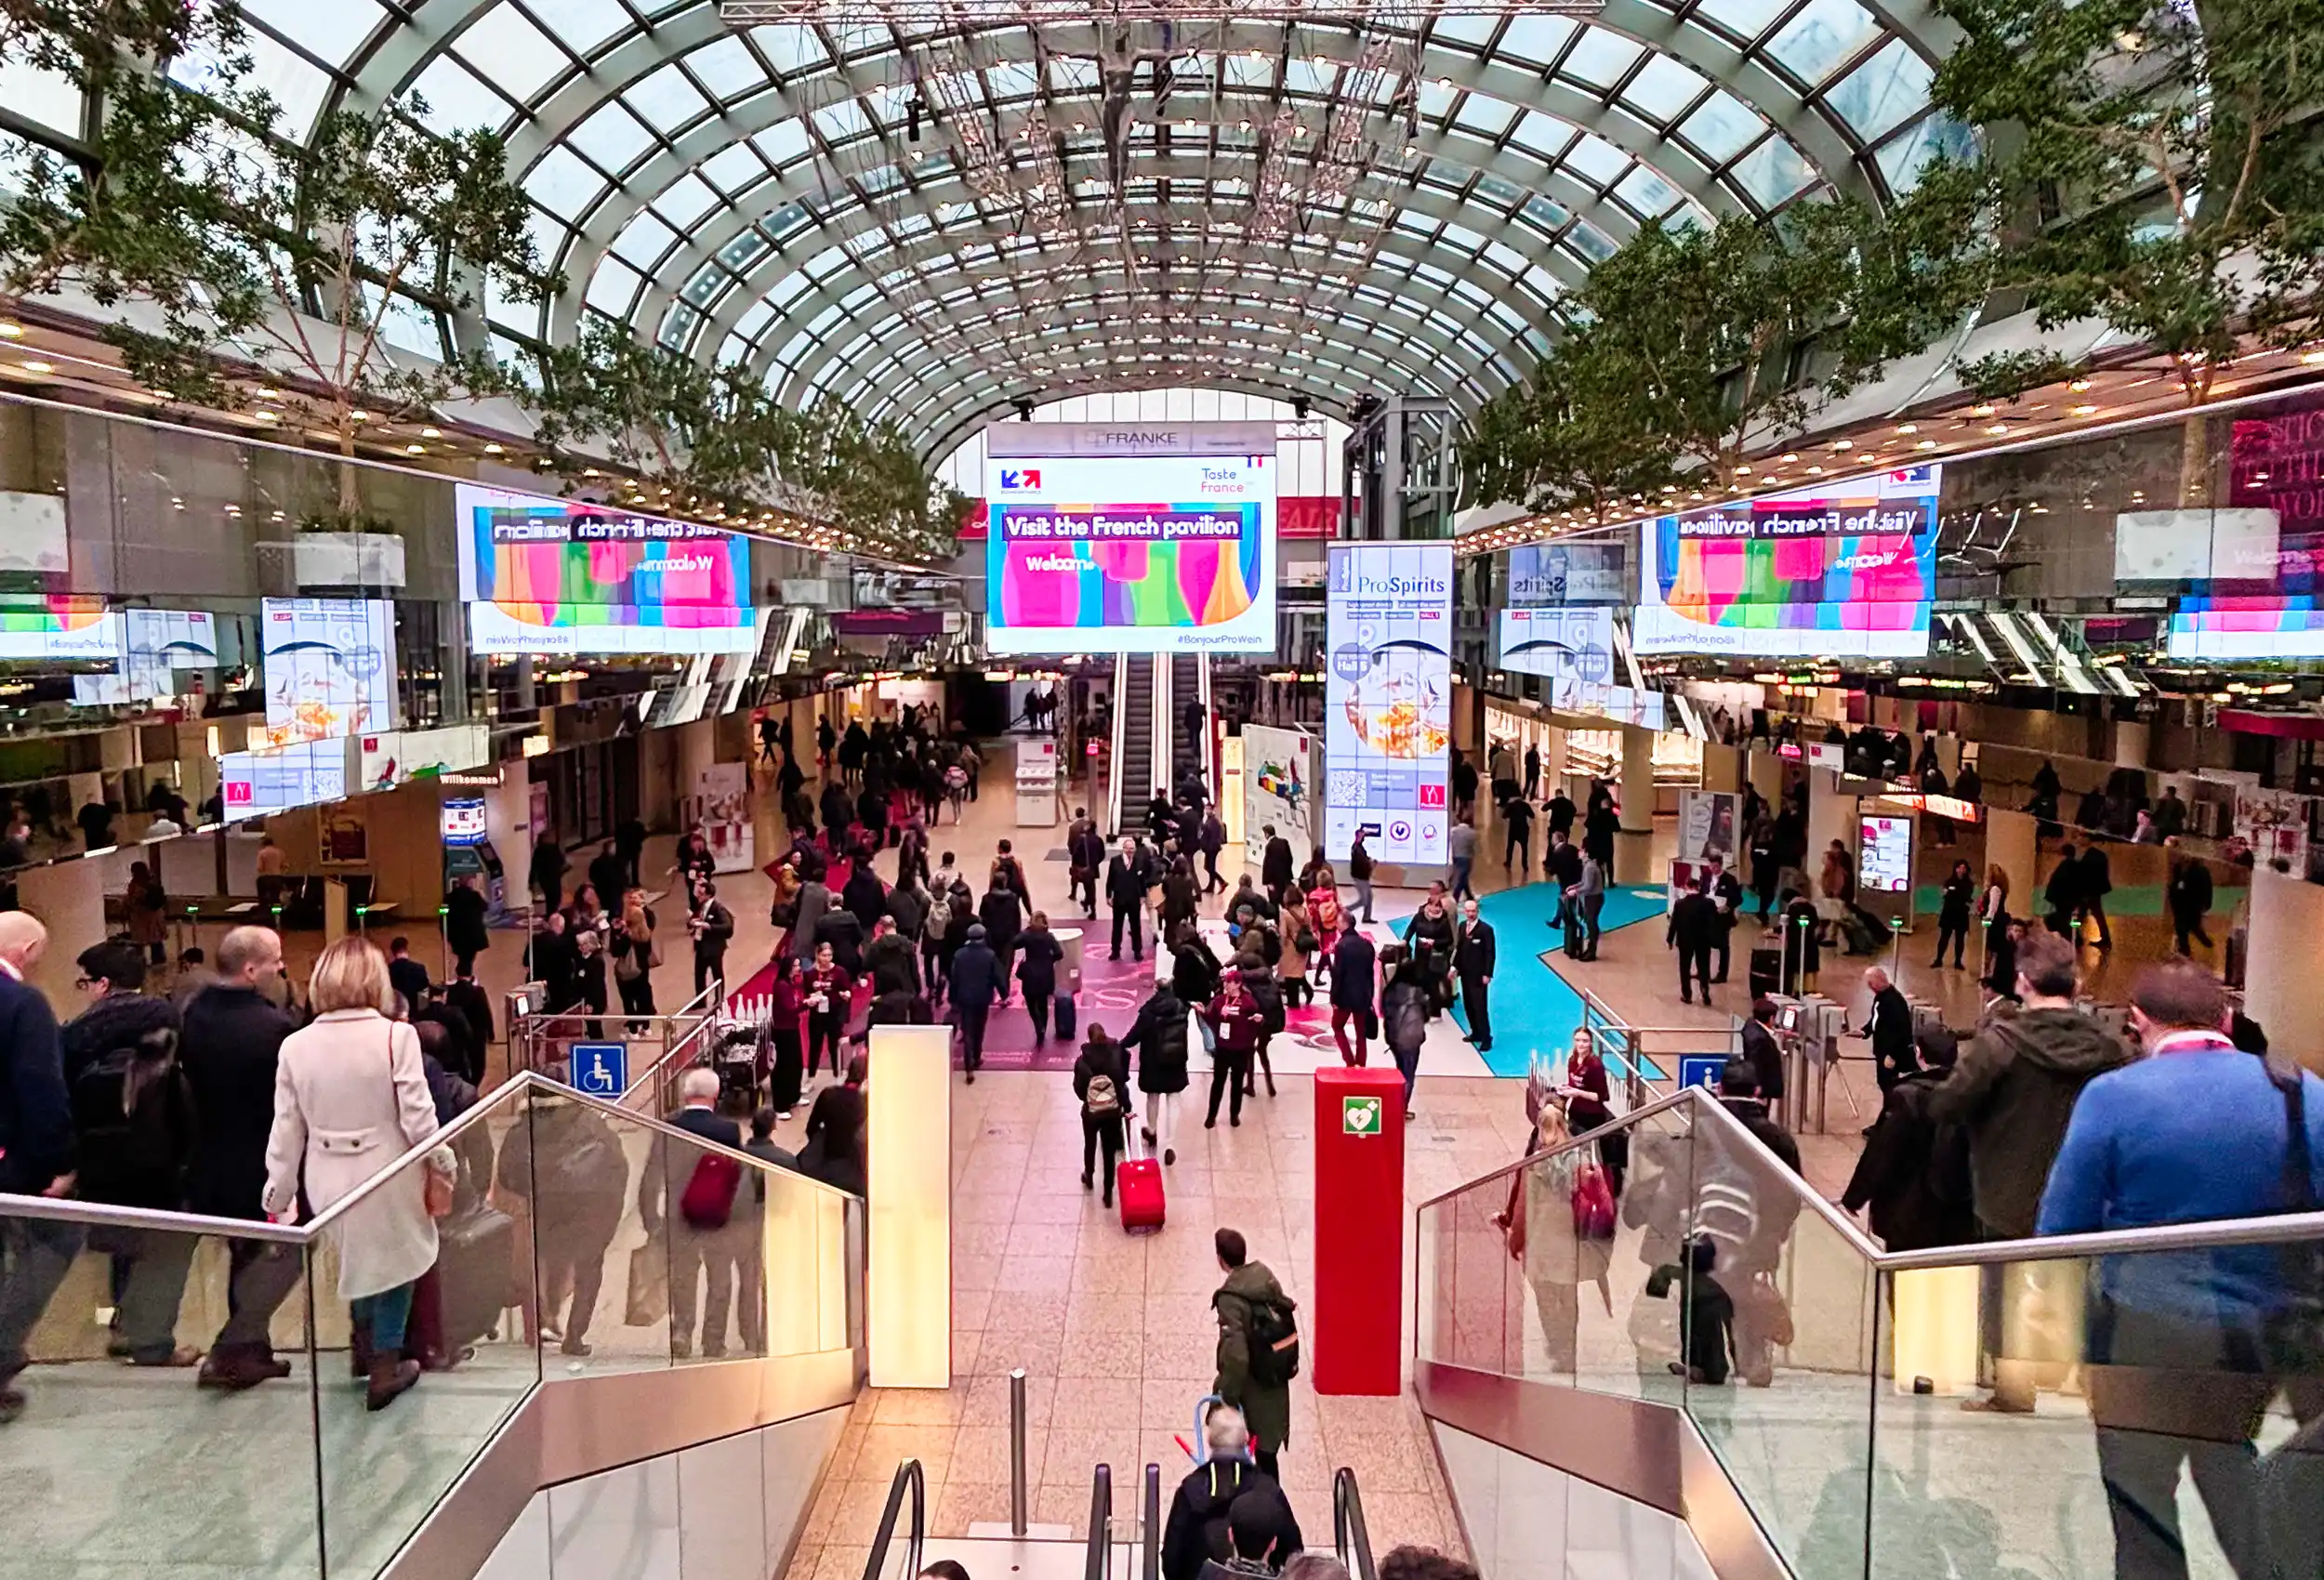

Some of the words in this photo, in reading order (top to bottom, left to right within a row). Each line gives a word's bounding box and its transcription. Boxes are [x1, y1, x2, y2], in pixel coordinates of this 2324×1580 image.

[1105, 431, 1178, 444] FRANKE
[1201, 467, 1237, 480] Taste
[1200, 481, 1245, 493] France
[1006, 516, 1051, 536] Visit
[1054, 518, 1089, 536] the
[1092, 516, 1160, 536] French
[1162, 517, 1238, 540] pavilion
[1026, 554, 1095, 572] Welcome
[1358, 575, 1446, 597] ProSpirits
[1177, 634, 1262, 647] #BonjourProWein
[439, 774, 499, 785] Willkommen
